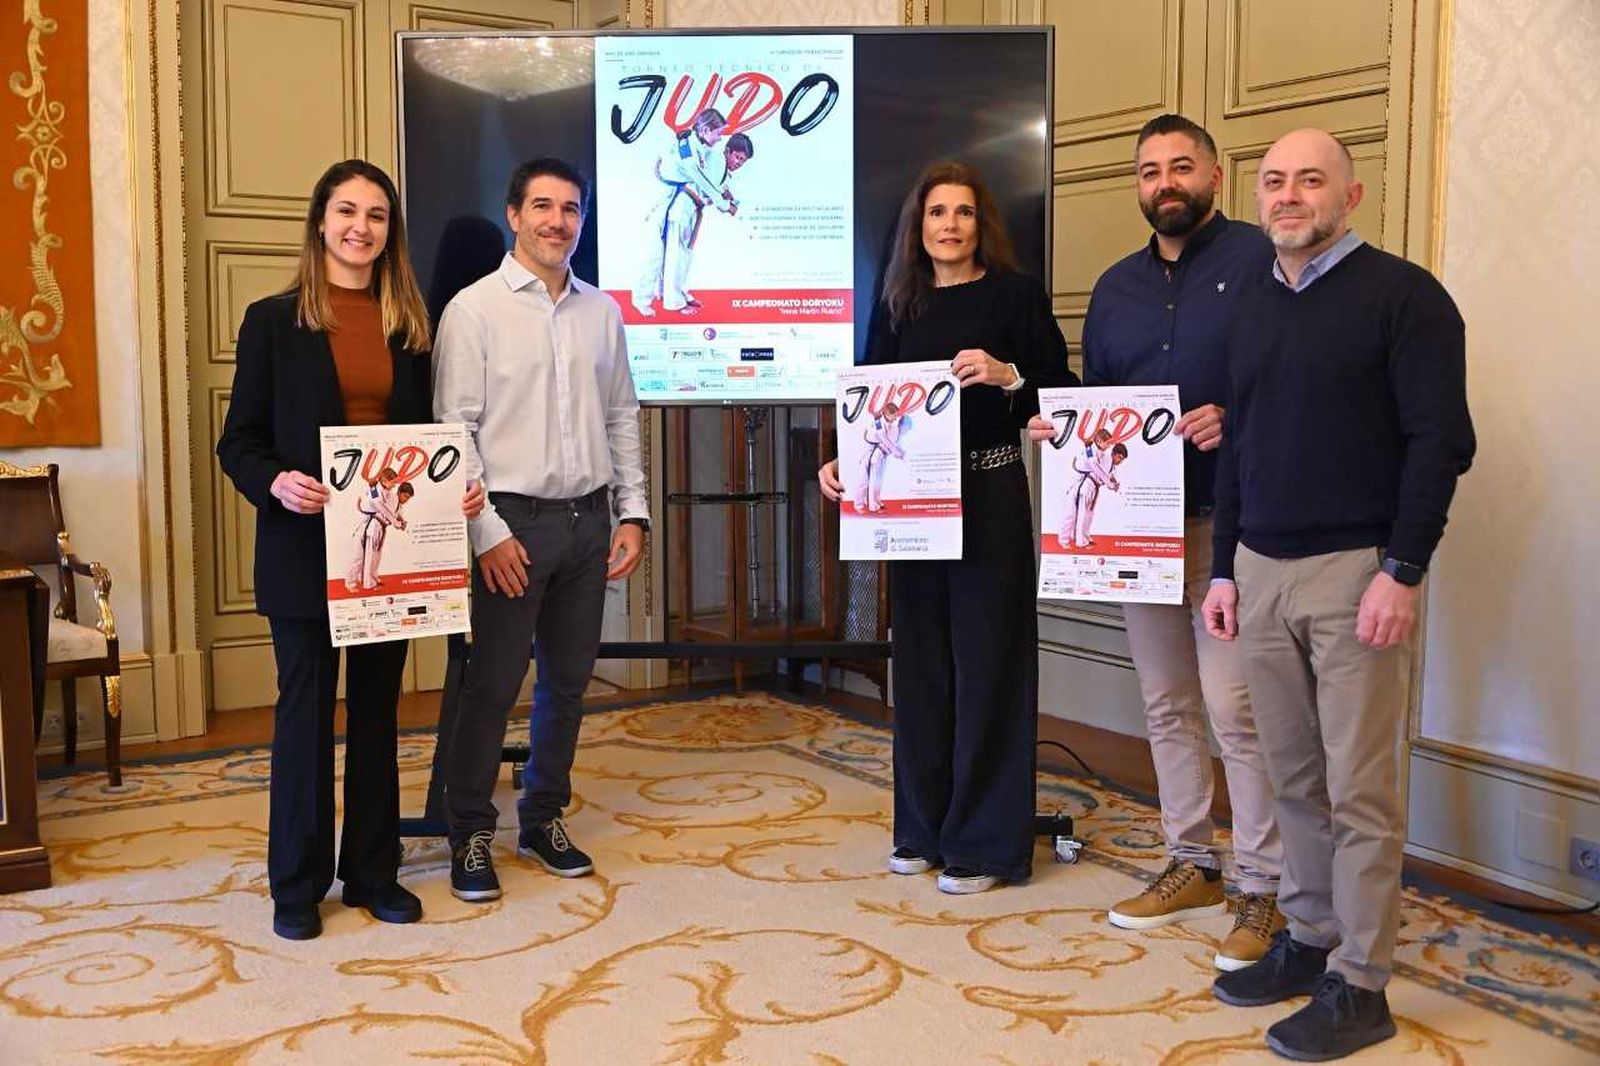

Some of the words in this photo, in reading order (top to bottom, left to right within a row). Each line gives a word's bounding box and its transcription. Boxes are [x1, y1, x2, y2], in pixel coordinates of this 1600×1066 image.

[611, 72, 839, 144] JUDO
[742, 299, 801, 308] CAMPEONATO
[842, 381, 955, 424] JUDO
[1050, 407, 1175, 450] JUDO
[330, 445, 460, 491] JUDO
